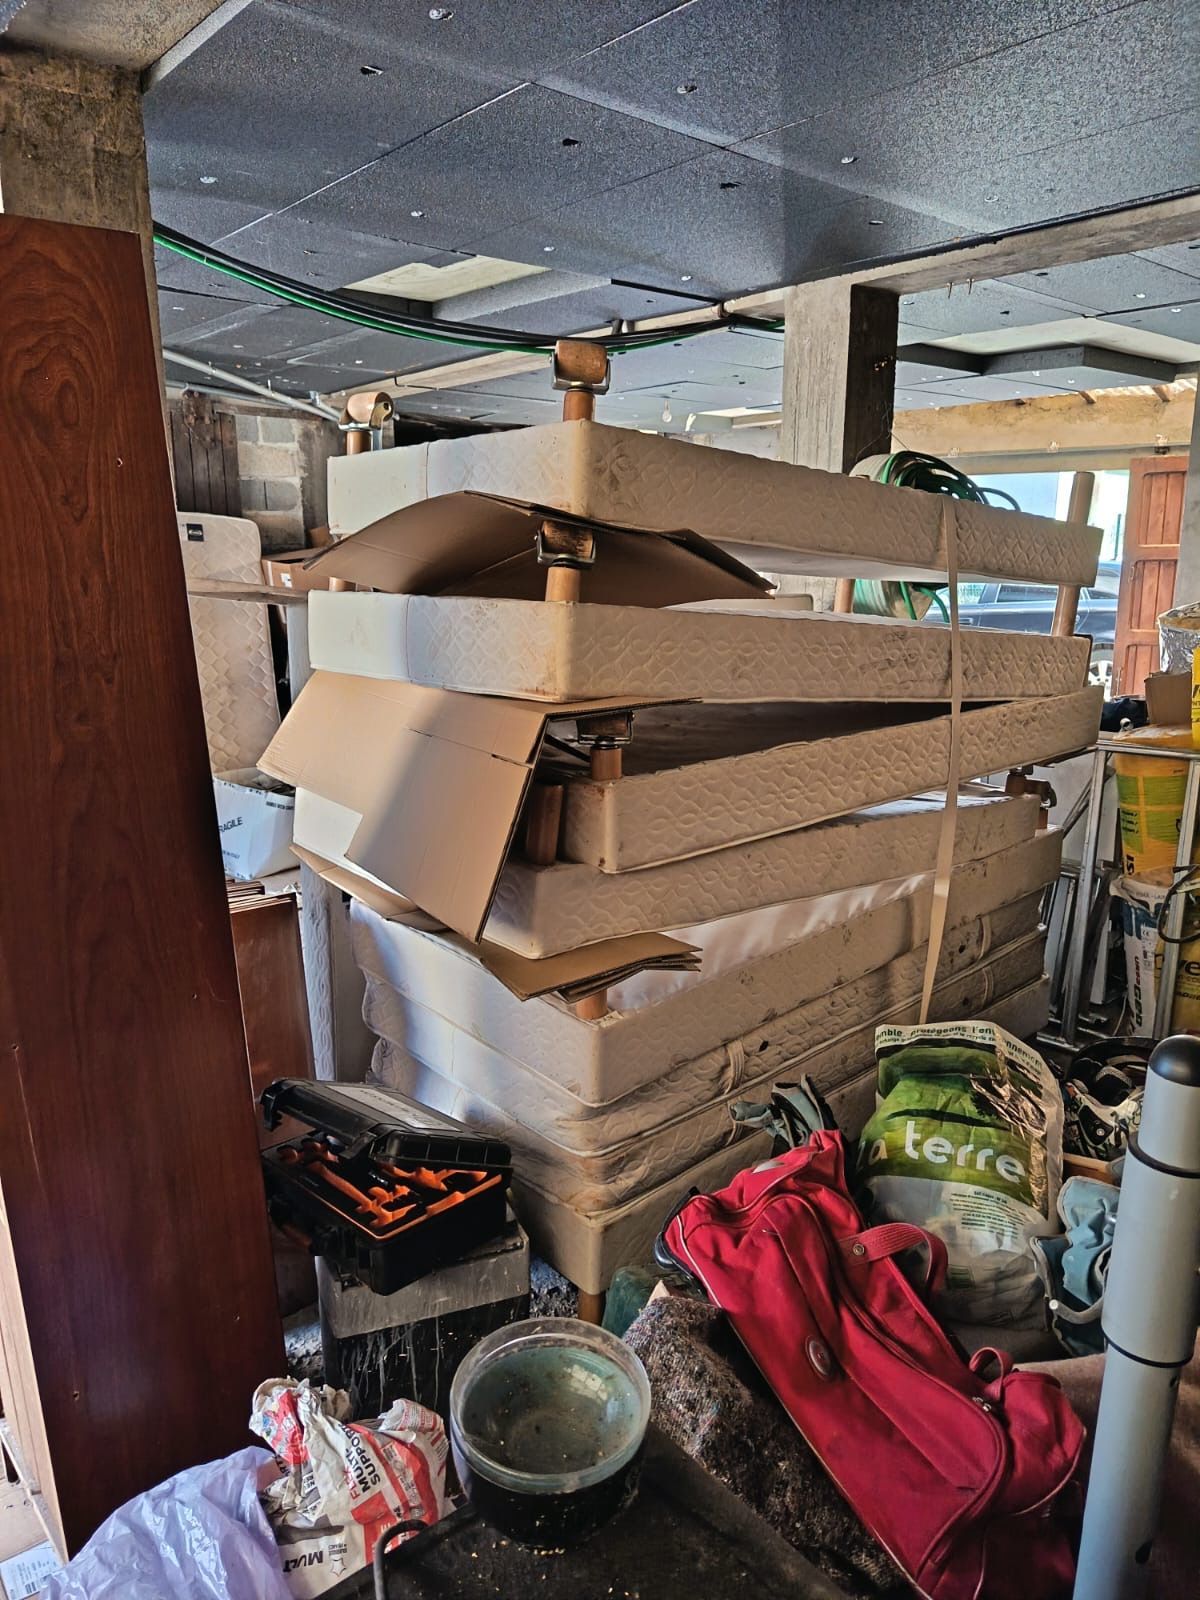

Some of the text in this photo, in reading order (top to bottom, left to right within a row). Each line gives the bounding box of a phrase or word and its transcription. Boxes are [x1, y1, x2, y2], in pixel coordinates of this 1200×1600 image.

[218, 816, 244, 833] RAGILE
[905, 1120, 1026, 1184] terre
[346, 1448, 371, 1493] MULTI-
